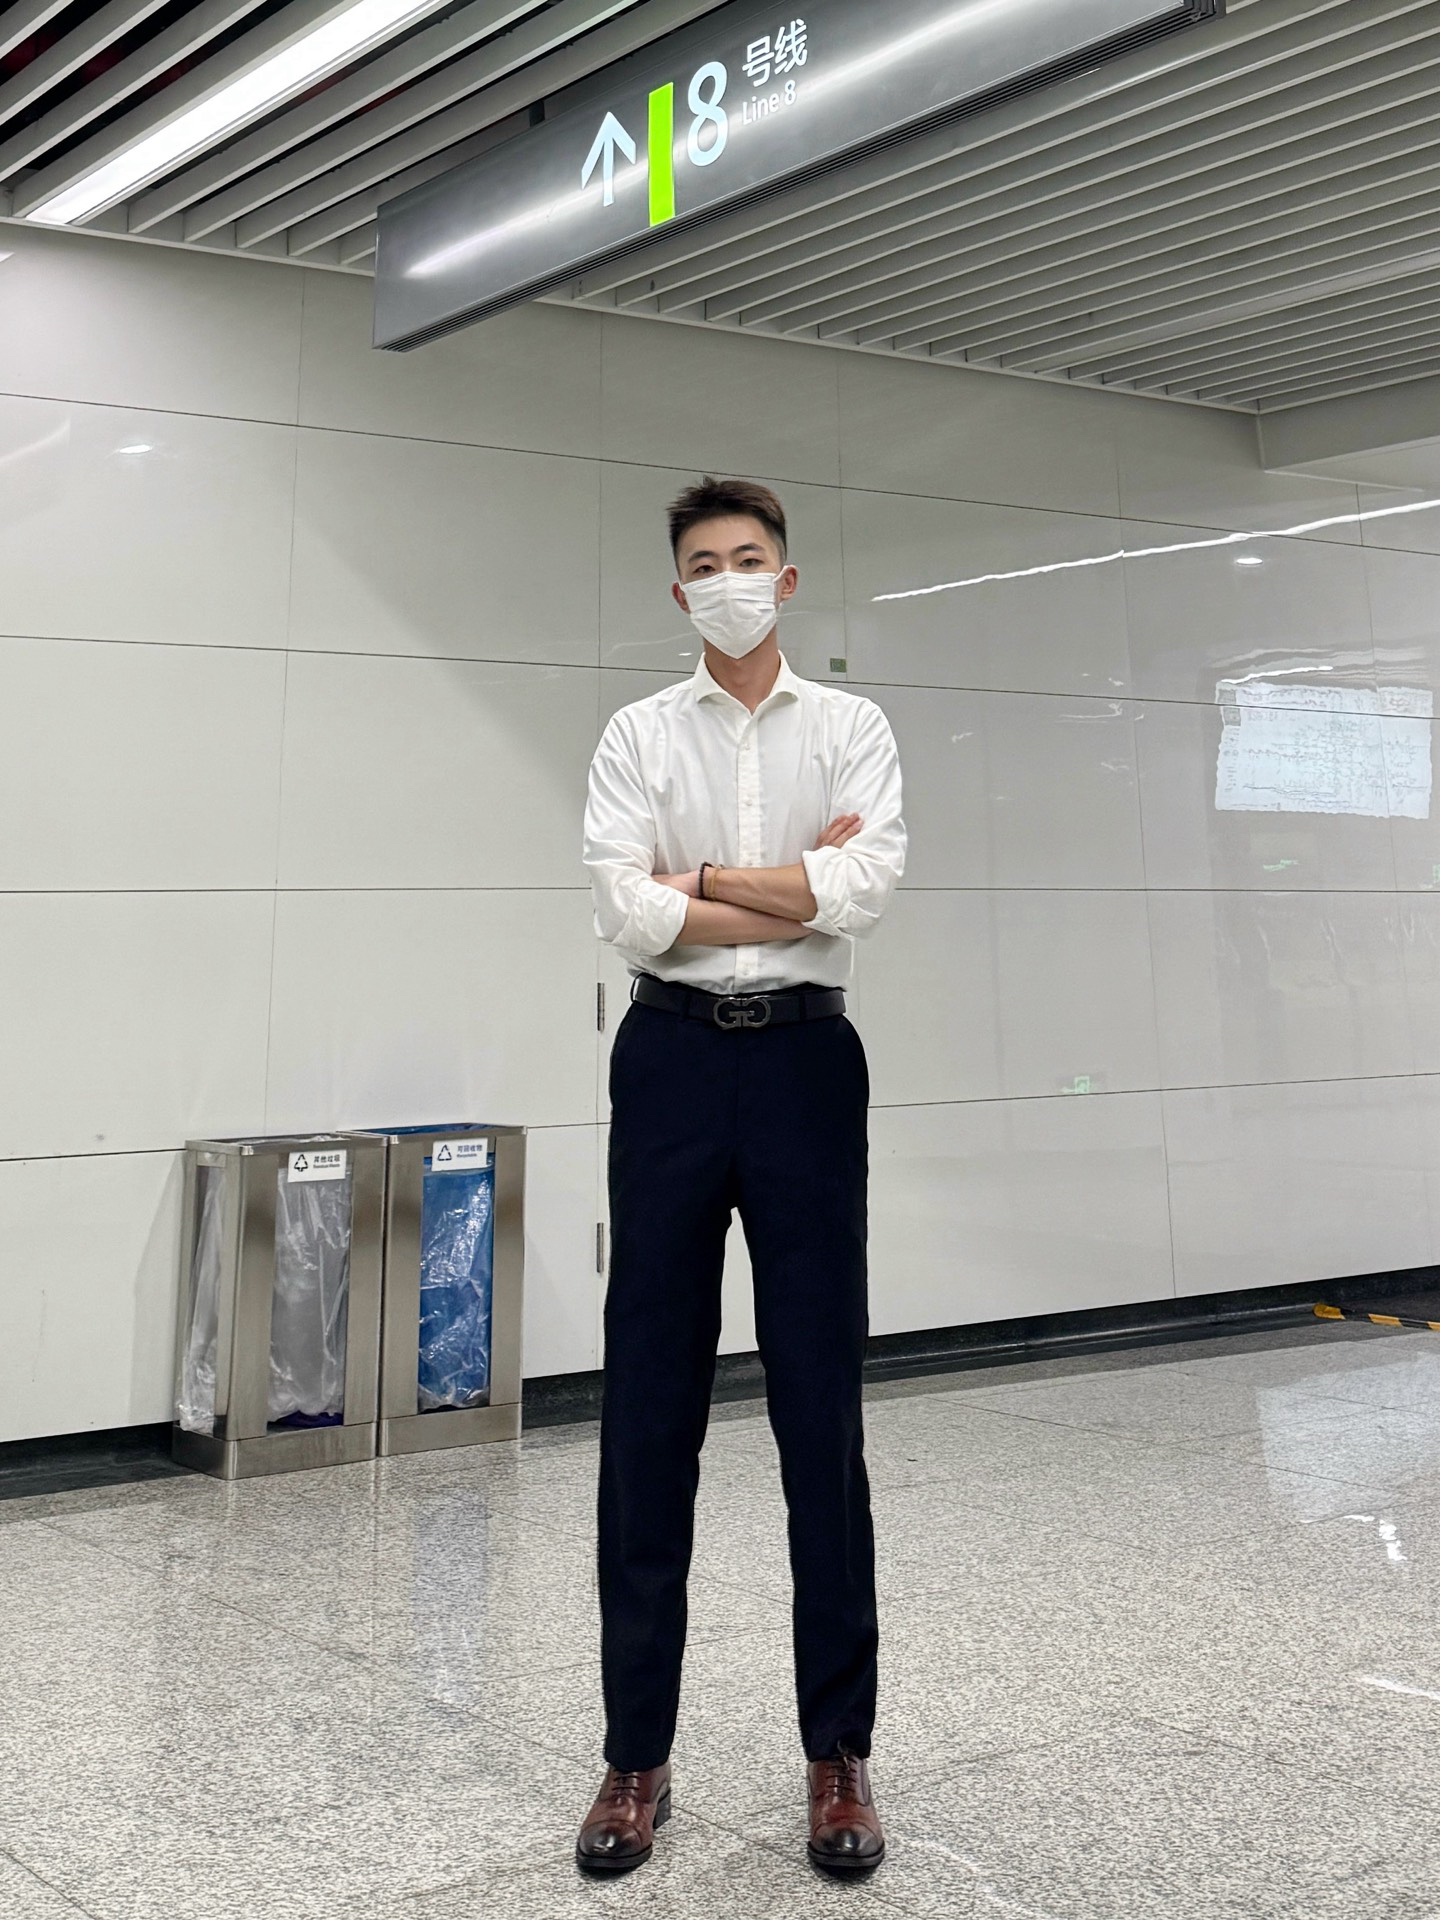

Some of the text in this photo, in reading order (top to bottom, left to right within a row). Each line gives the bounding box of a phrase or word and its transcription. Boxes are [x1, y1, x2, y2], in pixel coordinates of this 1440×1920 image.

[688, 19, 808, 166] 8 号线
[742, 79, 797, 125] Line 8
